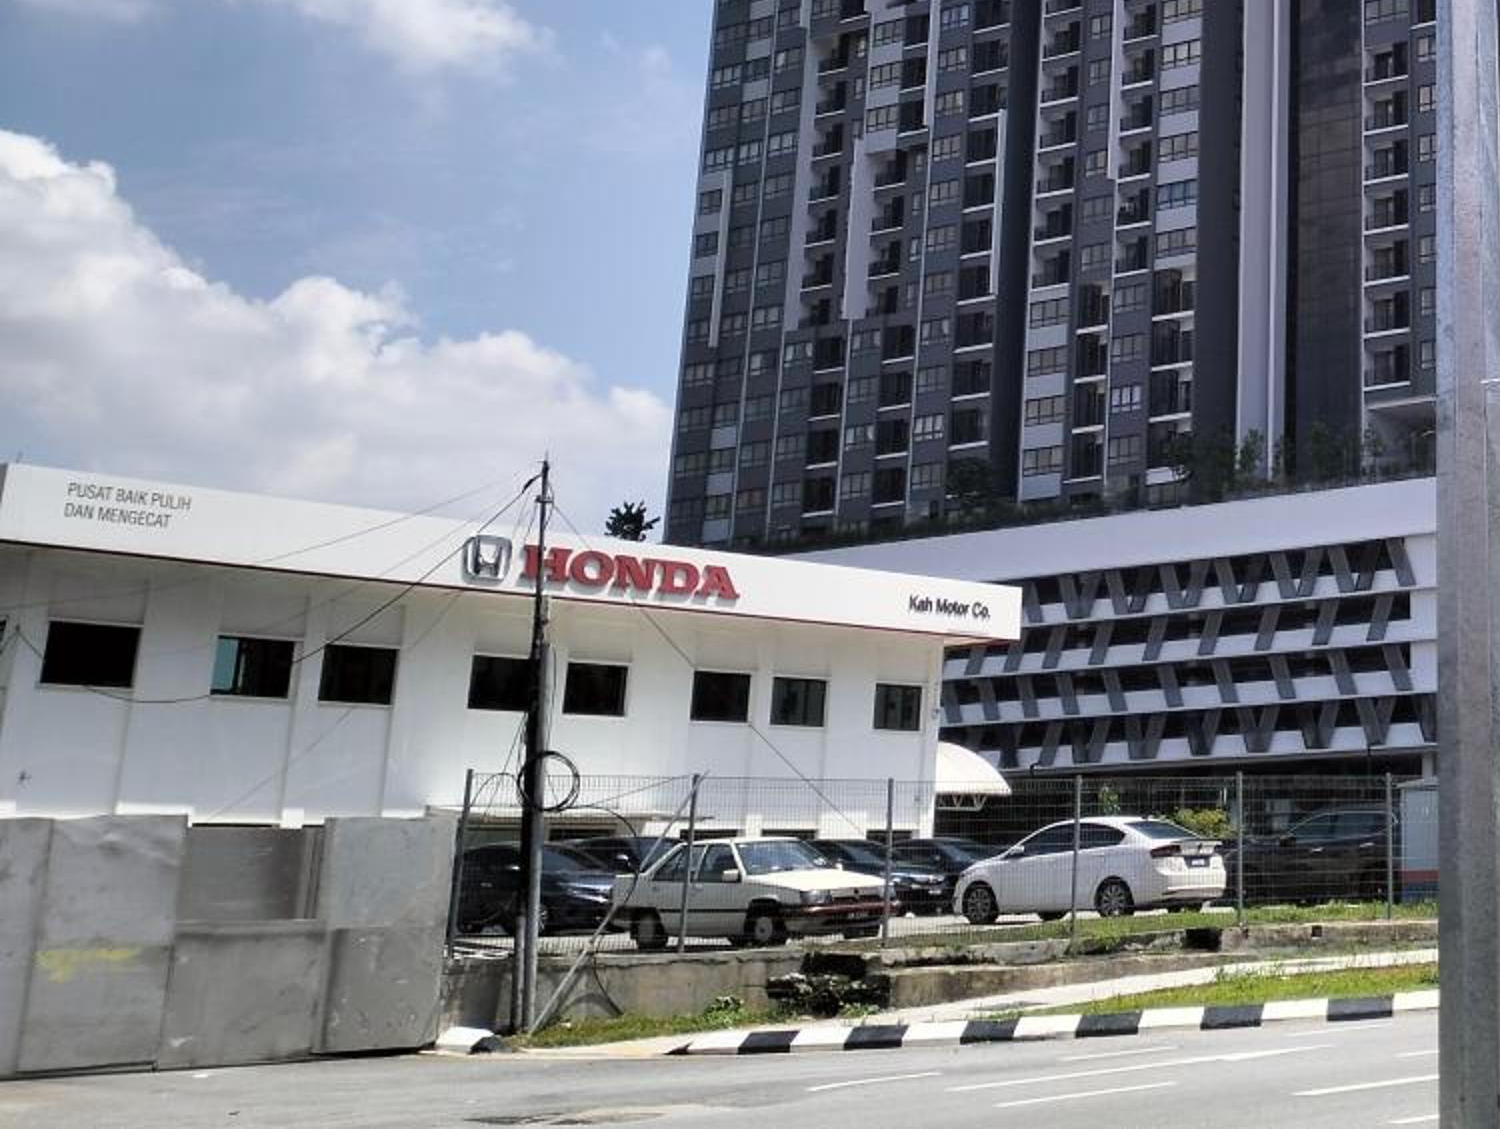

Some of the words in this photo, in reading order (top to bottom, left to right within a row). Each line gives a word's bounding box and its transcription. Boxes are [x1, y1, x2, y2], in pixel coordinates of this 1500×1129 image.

[67, 482, 113, 501] PUSAT
[115, 488, 149, 505] BAIK
[151, 491, 193, 511] PULIH
[63, 502, 95, 520] DAN
[97, 506, 172, 528] MENGECAT
[522, 543, 741, 600] HONDA
[908, 594, 933, 613] Kah
[935, 598, 970, 616] Motor
[971, 601, 991, 619] Co.
